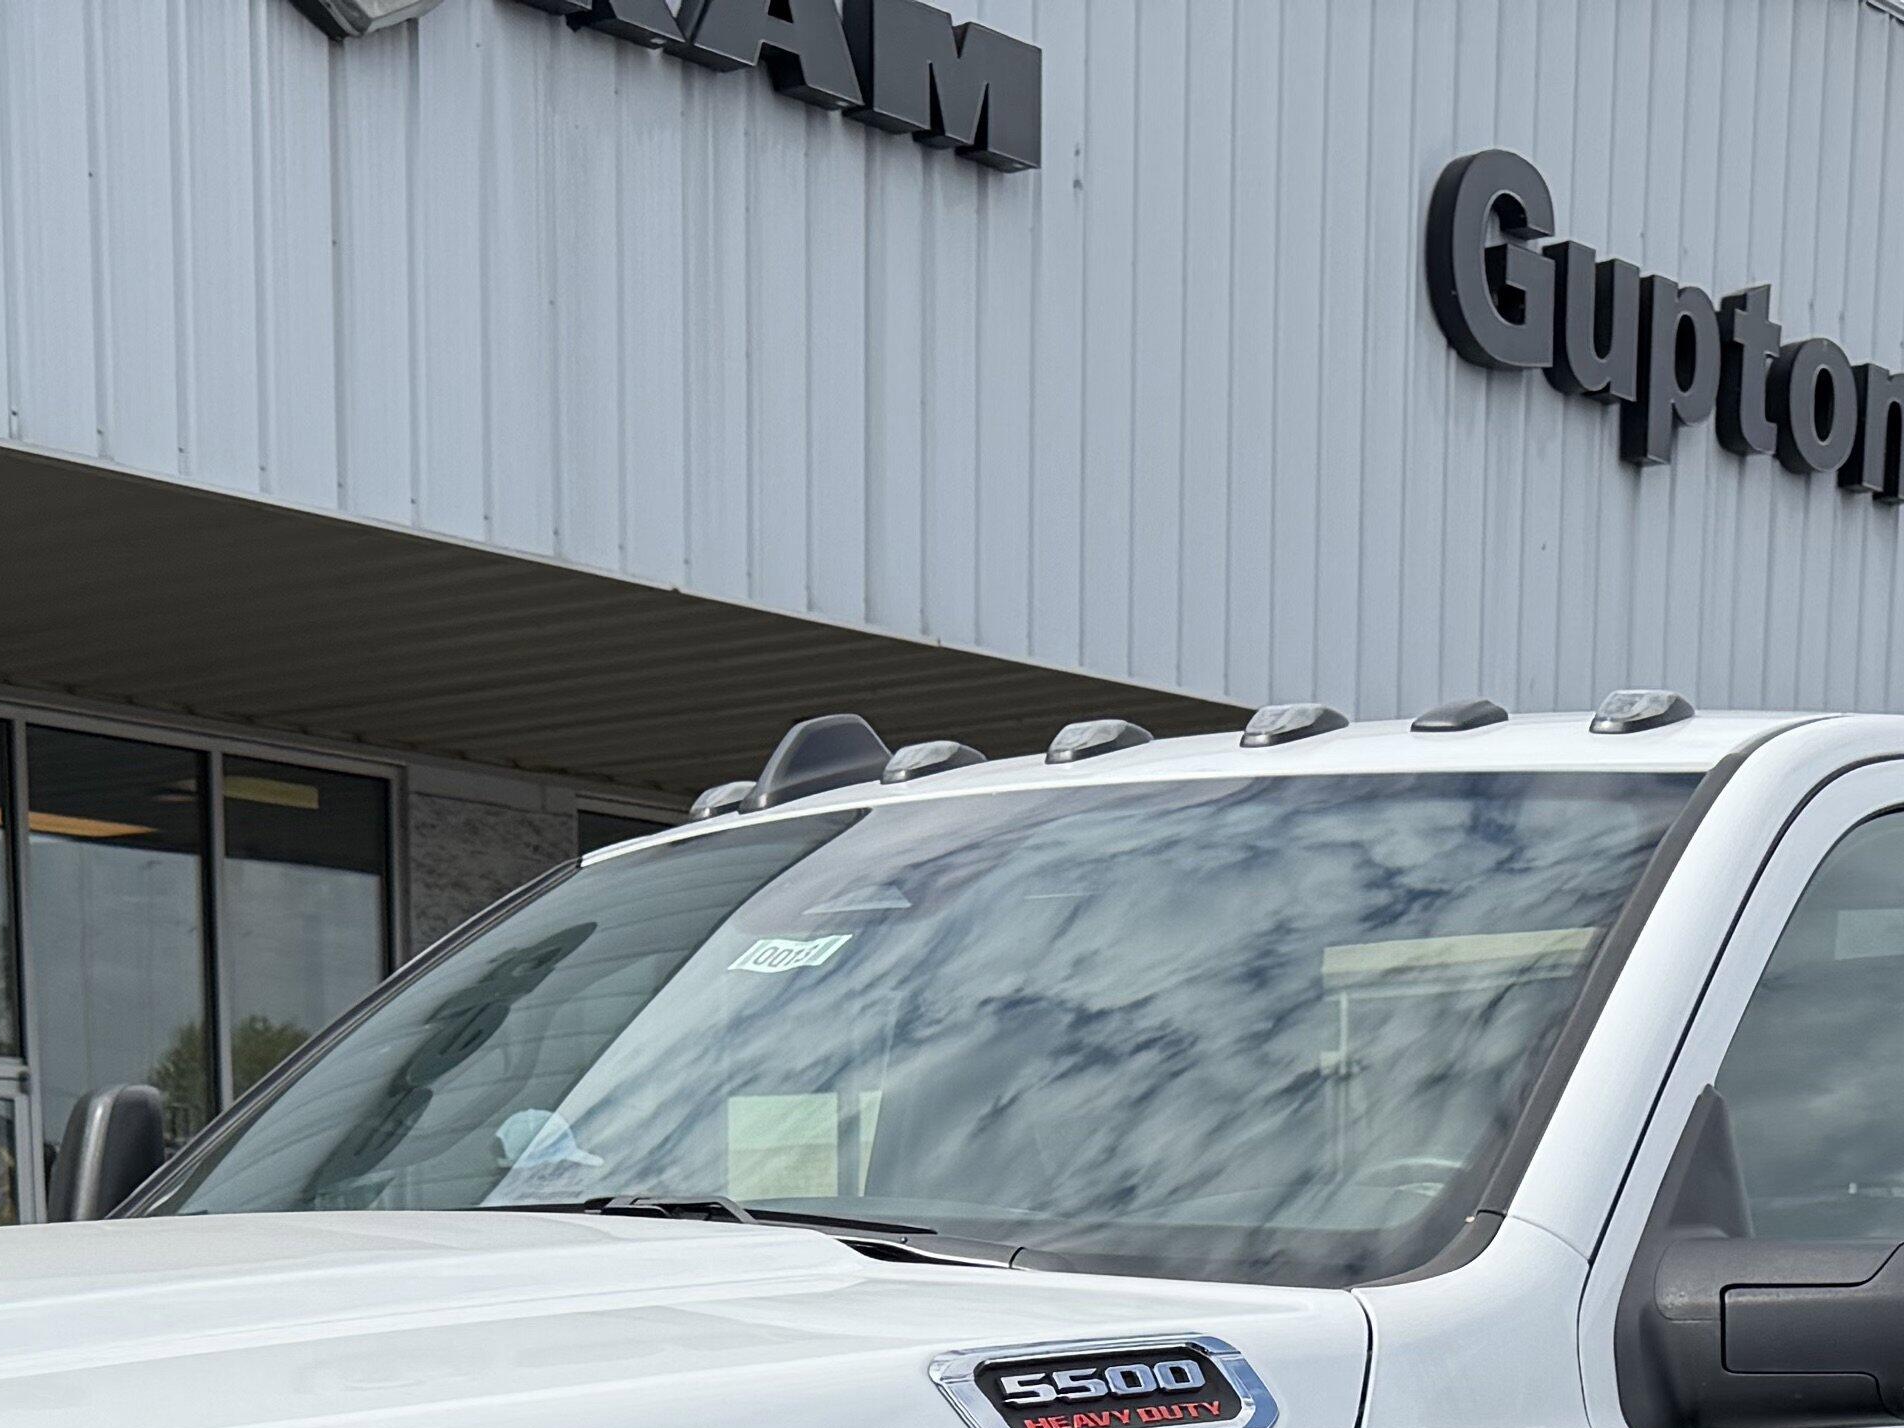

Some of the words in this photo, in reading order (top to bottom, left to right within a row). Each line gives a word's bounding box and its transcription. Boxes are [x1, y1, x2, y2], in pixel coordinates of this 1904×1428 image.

[496, 0, 1041, 172] AM
[1000, 1359, 1207, 1406] 5500
[1136, 1400, 1222, 1424] DUTY
